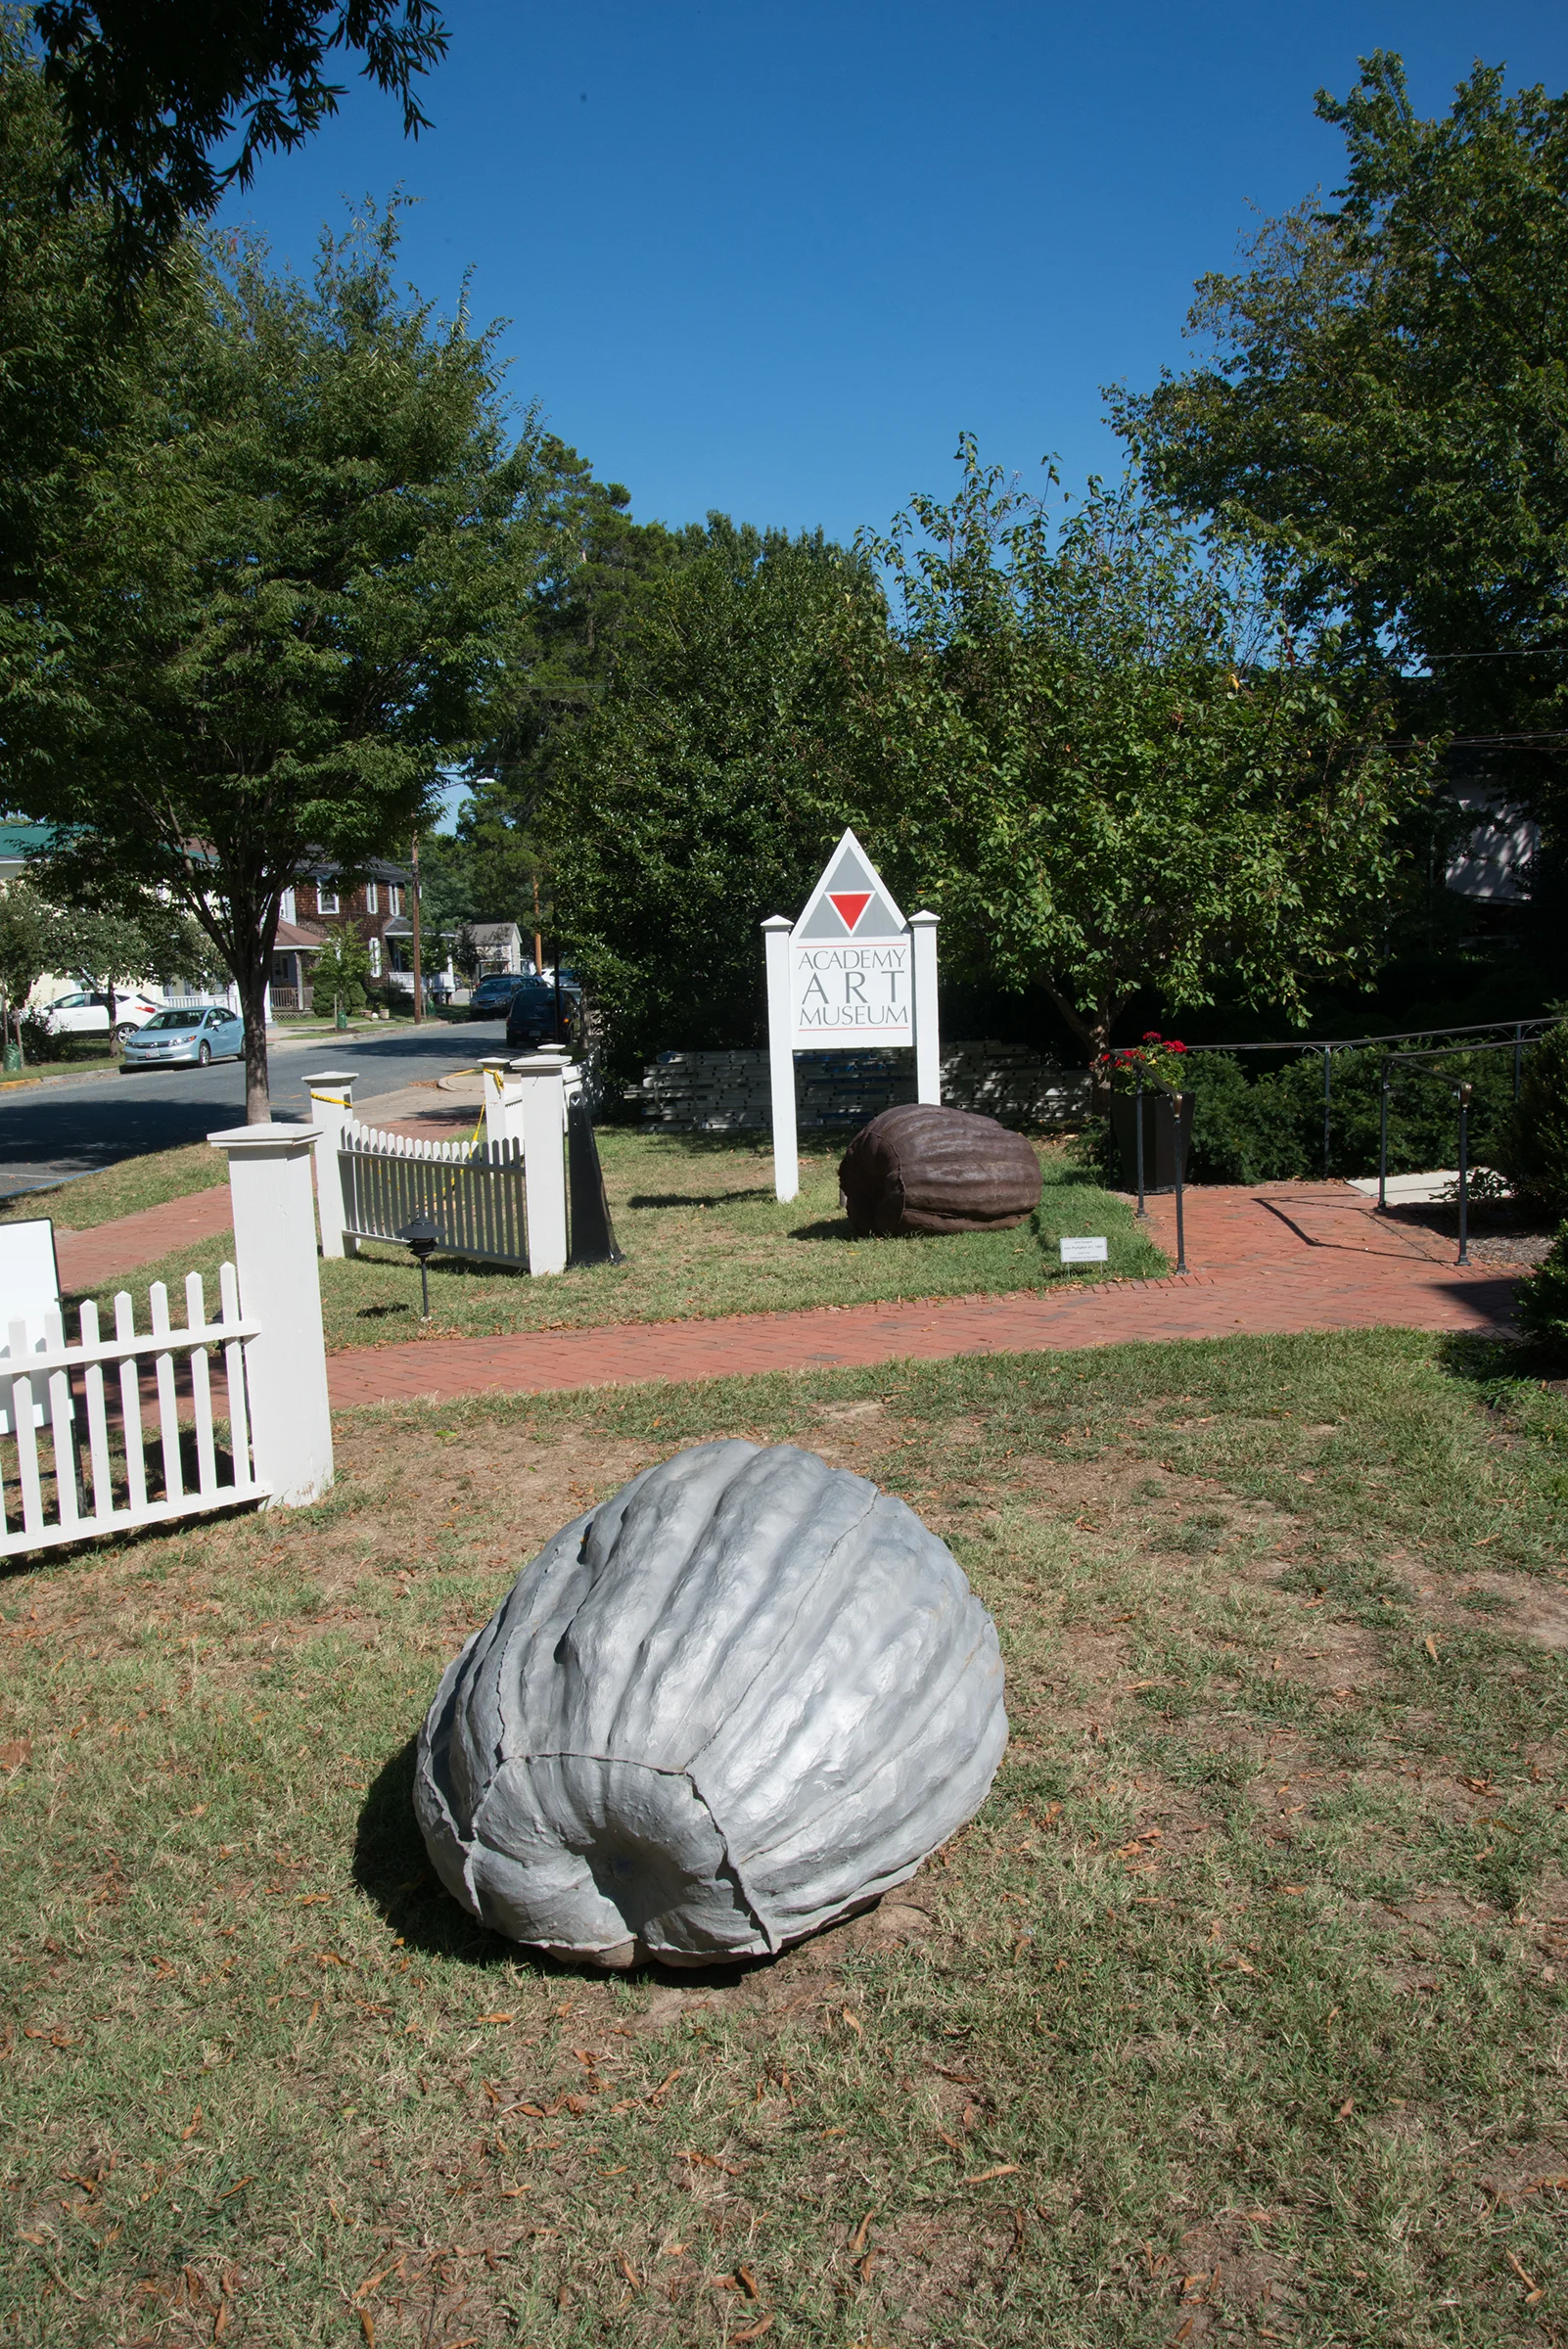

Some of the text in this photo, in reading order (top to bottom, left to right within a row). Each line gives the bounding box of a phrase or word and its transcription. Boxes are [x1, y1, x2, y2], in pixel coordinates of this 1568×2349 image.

[799, 948, 906, 971] ACADEMY
[802, 970, 905, 1005] ART
[800, 1005, 908, 1026] MUSEUM
